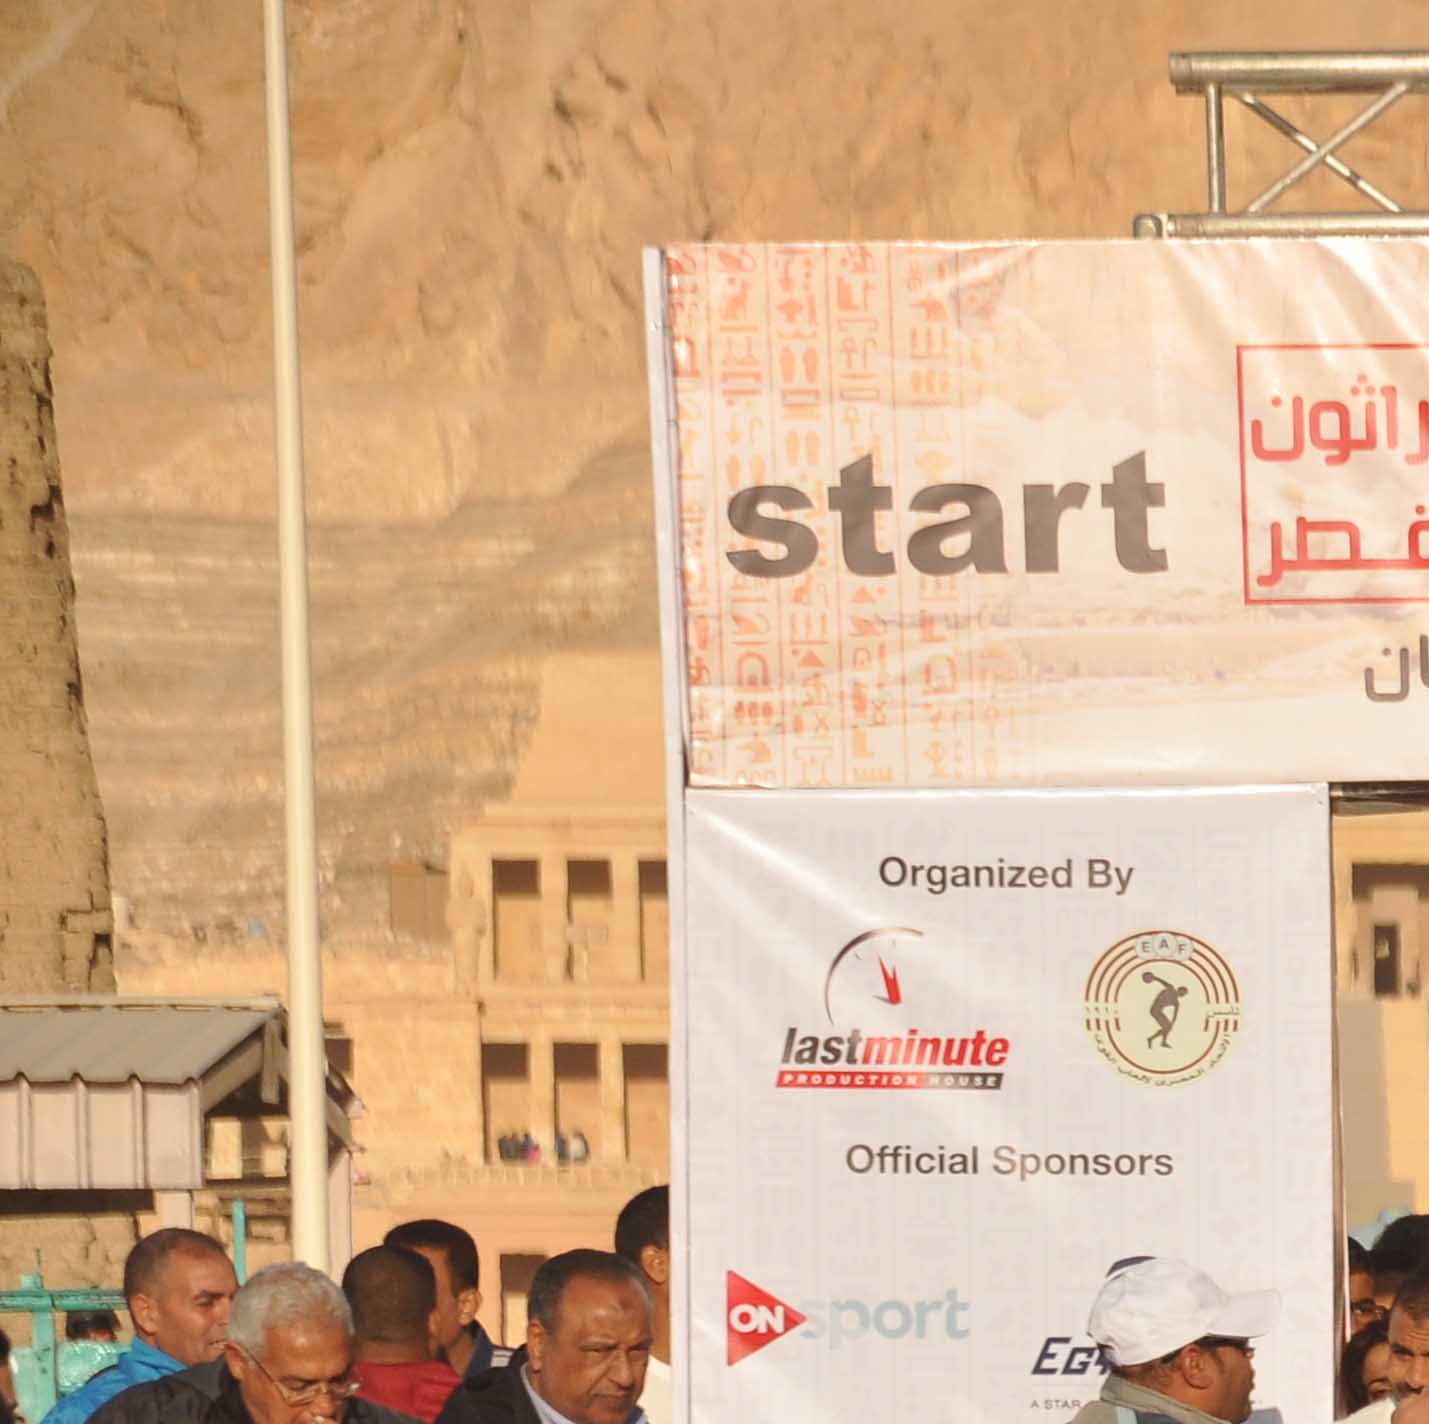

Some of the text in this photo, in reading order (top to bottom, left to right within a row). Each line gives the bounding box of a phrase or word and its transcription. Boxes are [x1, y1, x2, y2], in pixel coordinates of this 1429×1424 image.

[725, 449, 1170, 580] start
[878, 856, 1135, 896] Organized By
[1141, 937, 1188, 955] EAF
[780, 1028, 1010, 1068] lastminute
[782, 1073, 999, 1089] PRODUCTION HOUSE
[846, 1143, 1175, 1182] Official Sponsors
[729, 1287, 971, 1348] ON sport
